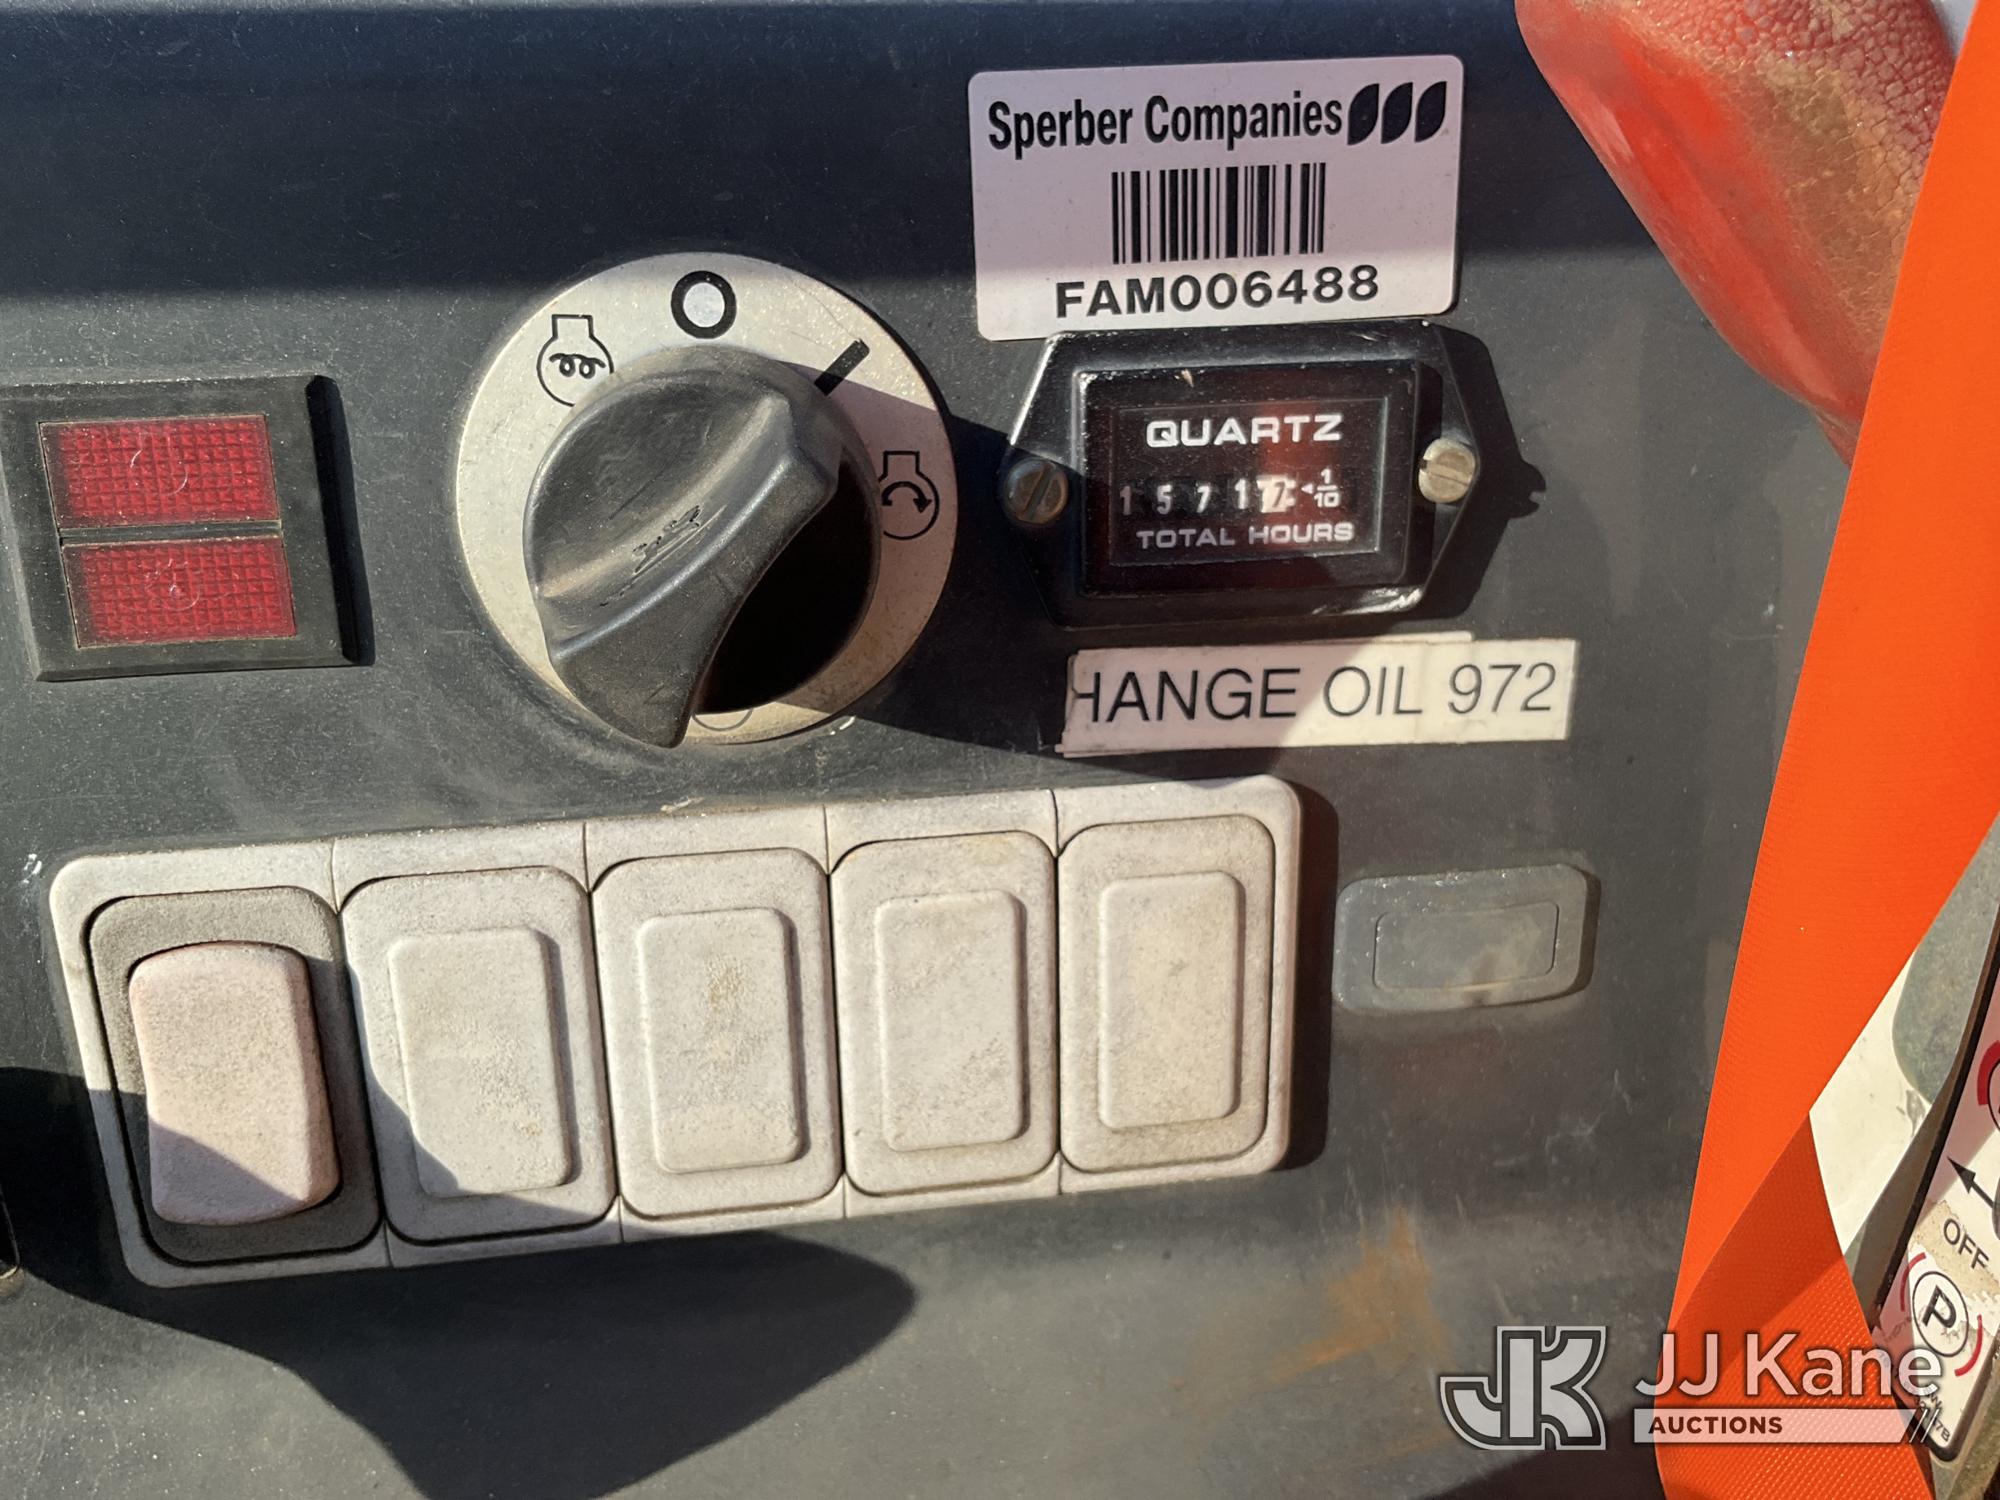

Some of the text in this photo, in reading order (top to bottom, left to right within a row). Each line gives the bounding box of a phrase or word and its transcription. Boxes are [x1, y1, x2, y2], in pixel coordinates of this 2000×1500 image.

[988, 91, 1343, 160] Sperber Companies
[1055, 264, 1380, 319] FAM006488
[1146, 414, 1343, 448] QUARTZ
[1136, 521, 1355, 550] TOTAL HOURS
[1323, 665, 1424, 717] OIL
[1448, 661, 1557, 715] 972
[1943, 1218, 1989, 1270] OFF
[1922, 1284, 1957, 1328] P
